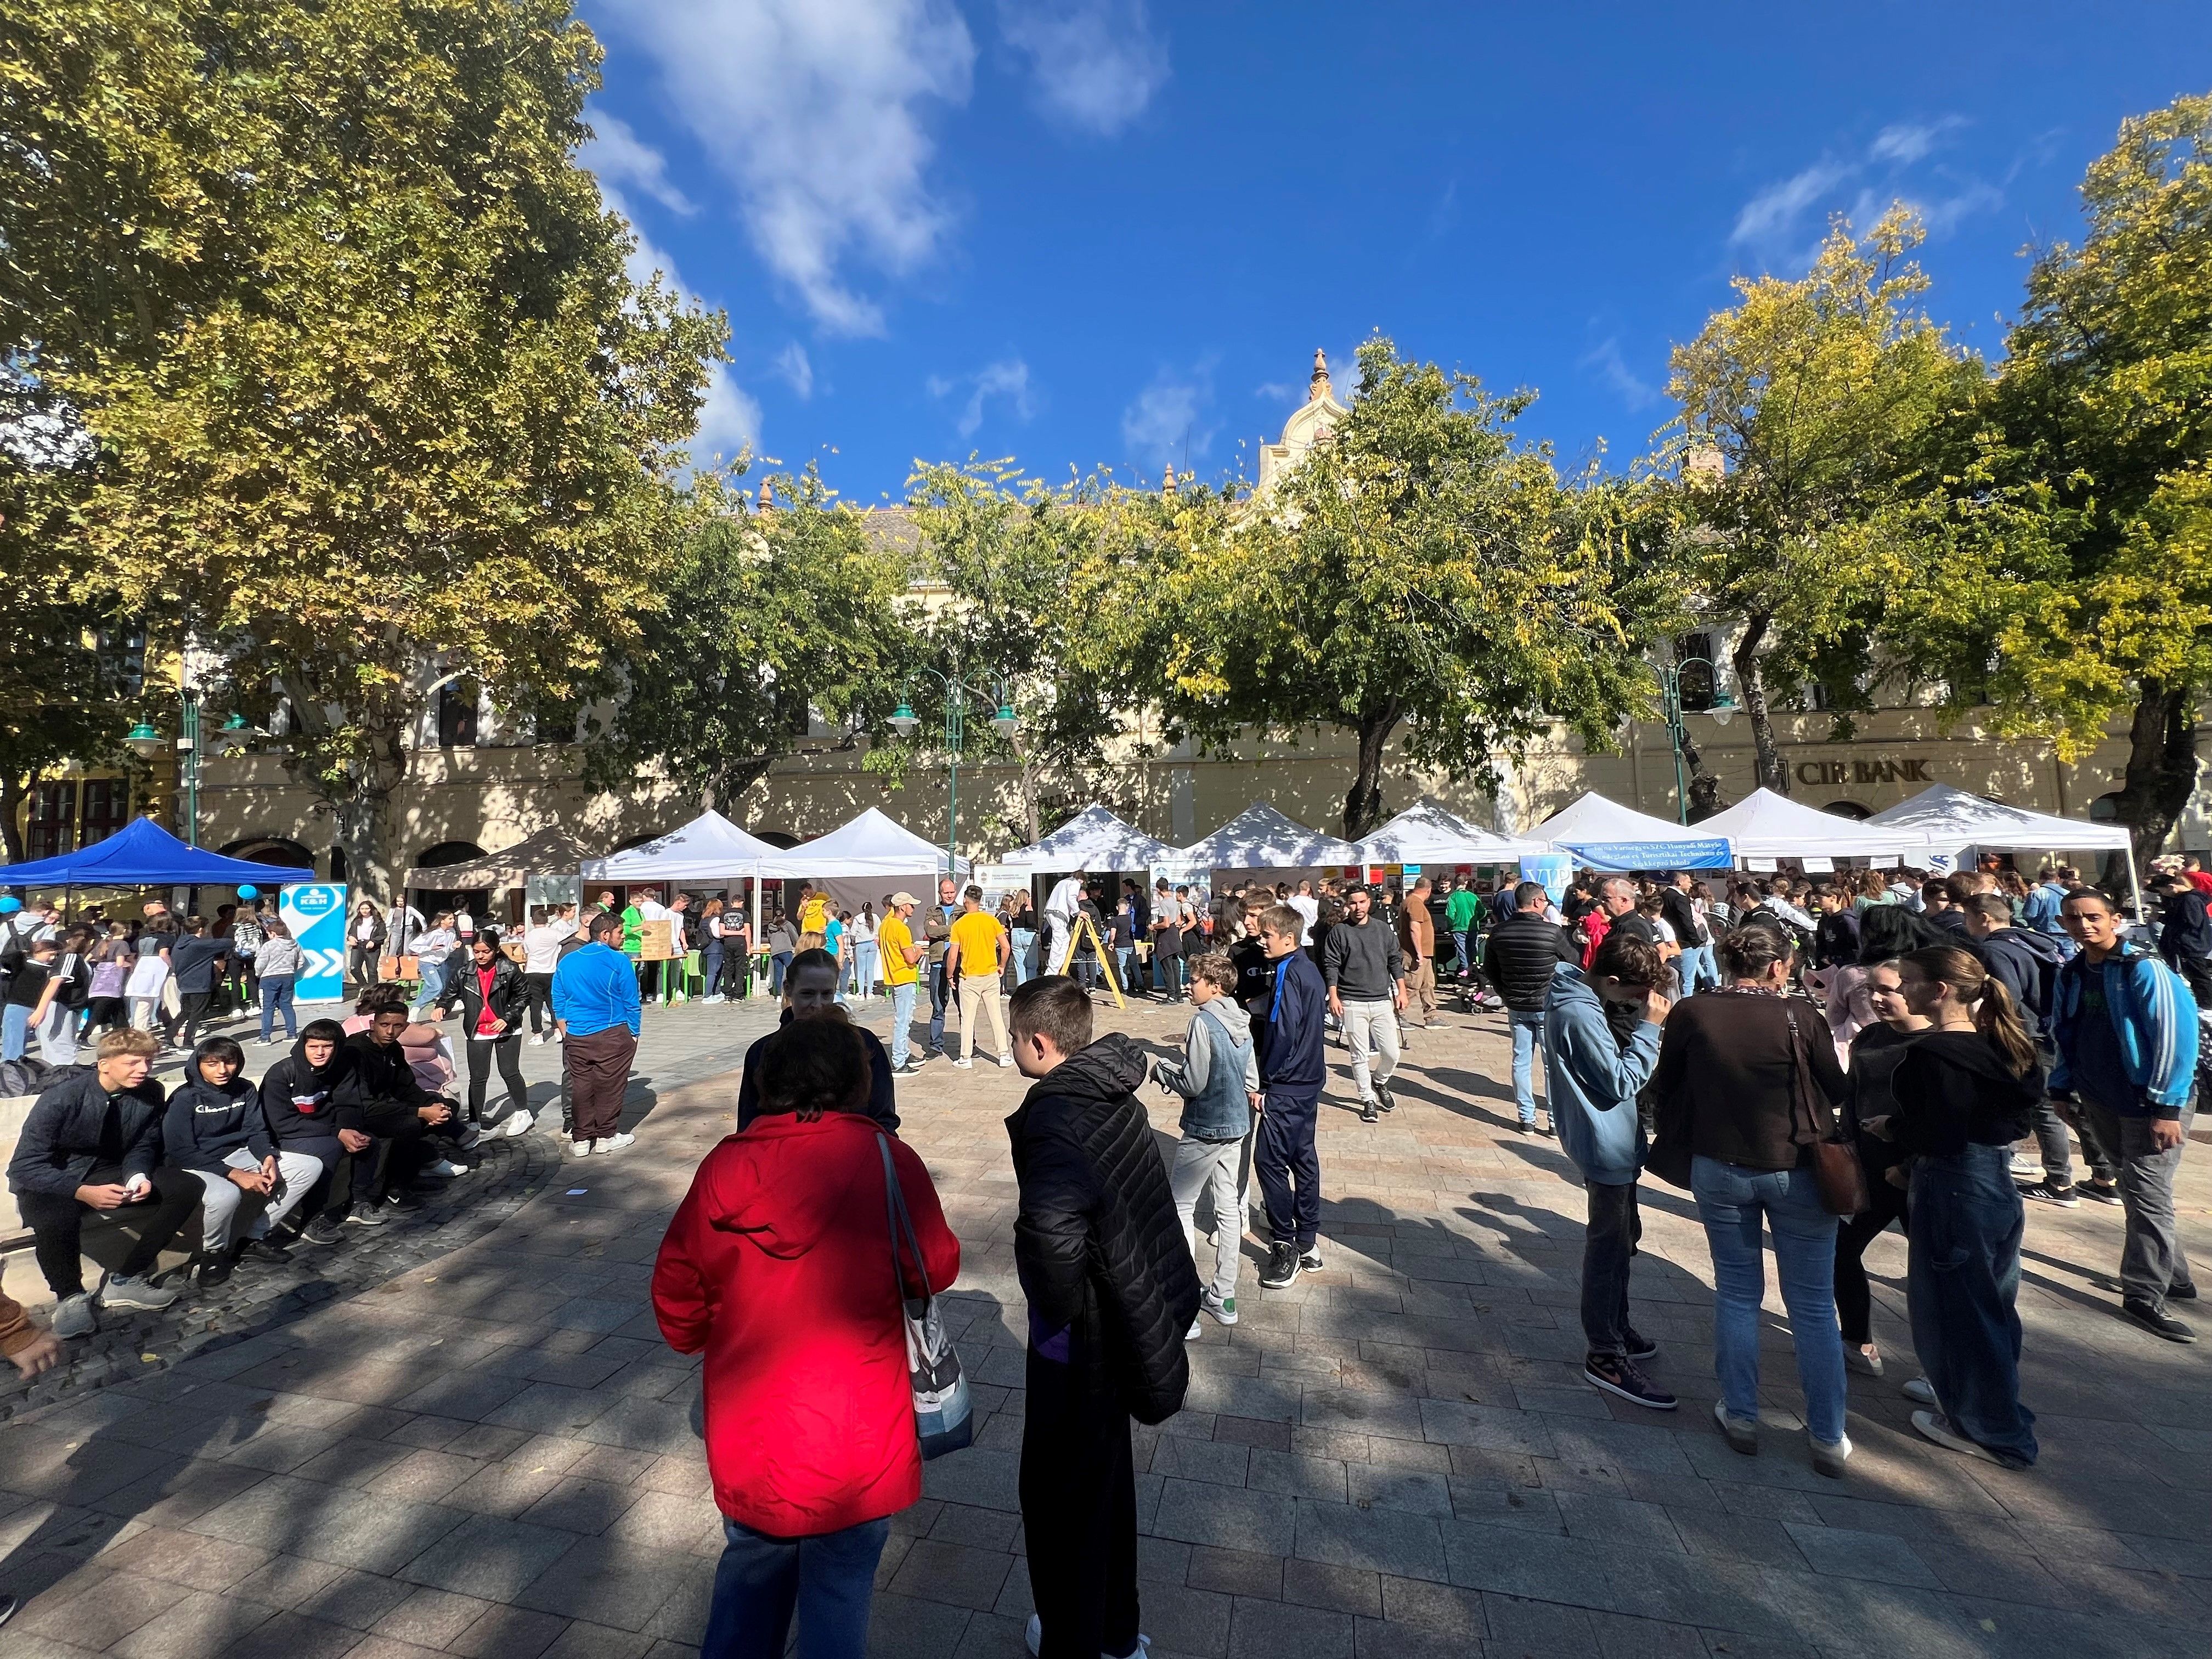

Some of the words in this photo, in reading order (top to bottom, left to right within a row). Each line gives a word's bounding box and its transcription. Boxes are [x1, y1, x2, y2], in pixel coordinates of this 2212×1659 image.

[1852, 759, 1935, 783] BANK
[1525, 868, 1570, 889] VIP
[195, 1101, 245, 1113] Champon
